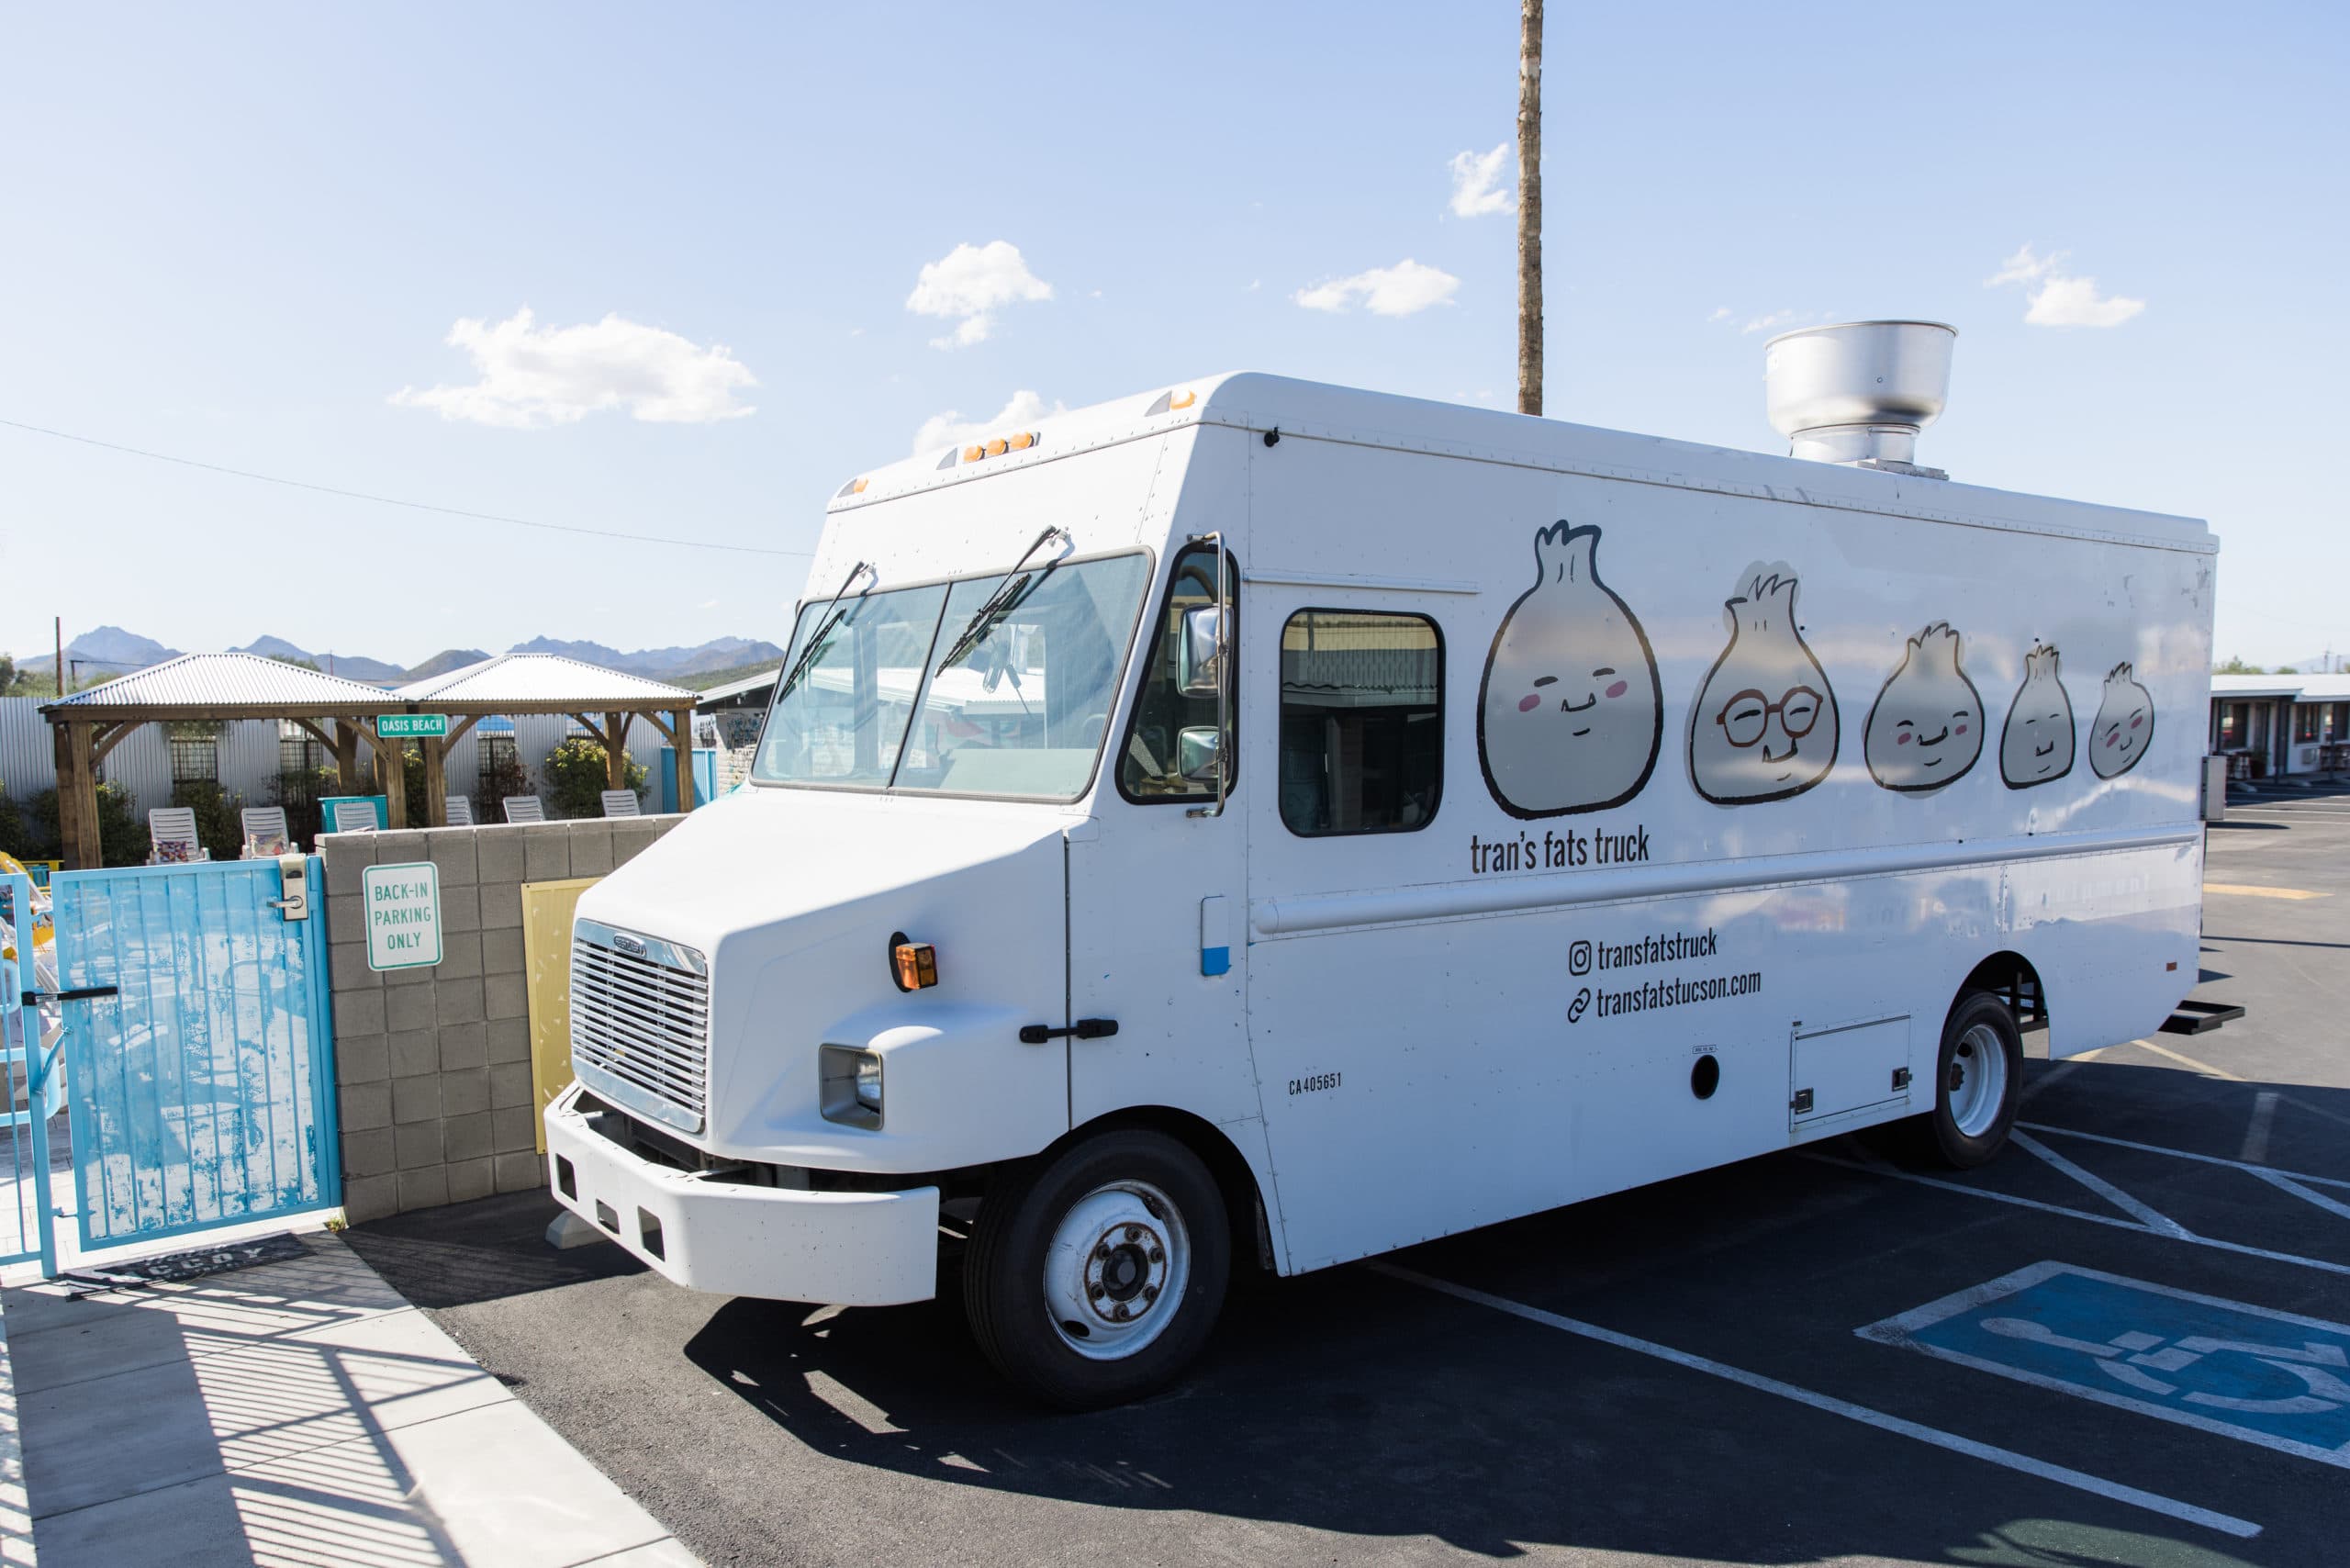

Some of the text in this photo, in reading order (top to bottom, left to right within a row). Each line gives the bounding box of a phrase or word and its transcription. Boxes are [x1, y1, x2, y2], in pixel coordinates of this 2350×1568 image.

[382, 719, 442, 732] OASIS BEACH
[1471, 823, 1650, 874] tran's fats truck
[375, 881, 428, 902] BACK-IN
[375, 906, 431, 926] PARKING
[387, 932, 421, 950] ONLY
[1597, 926, 1718, 970] transfatstruck
[1596, 971, 1762, 1017] transfatstucson.com
